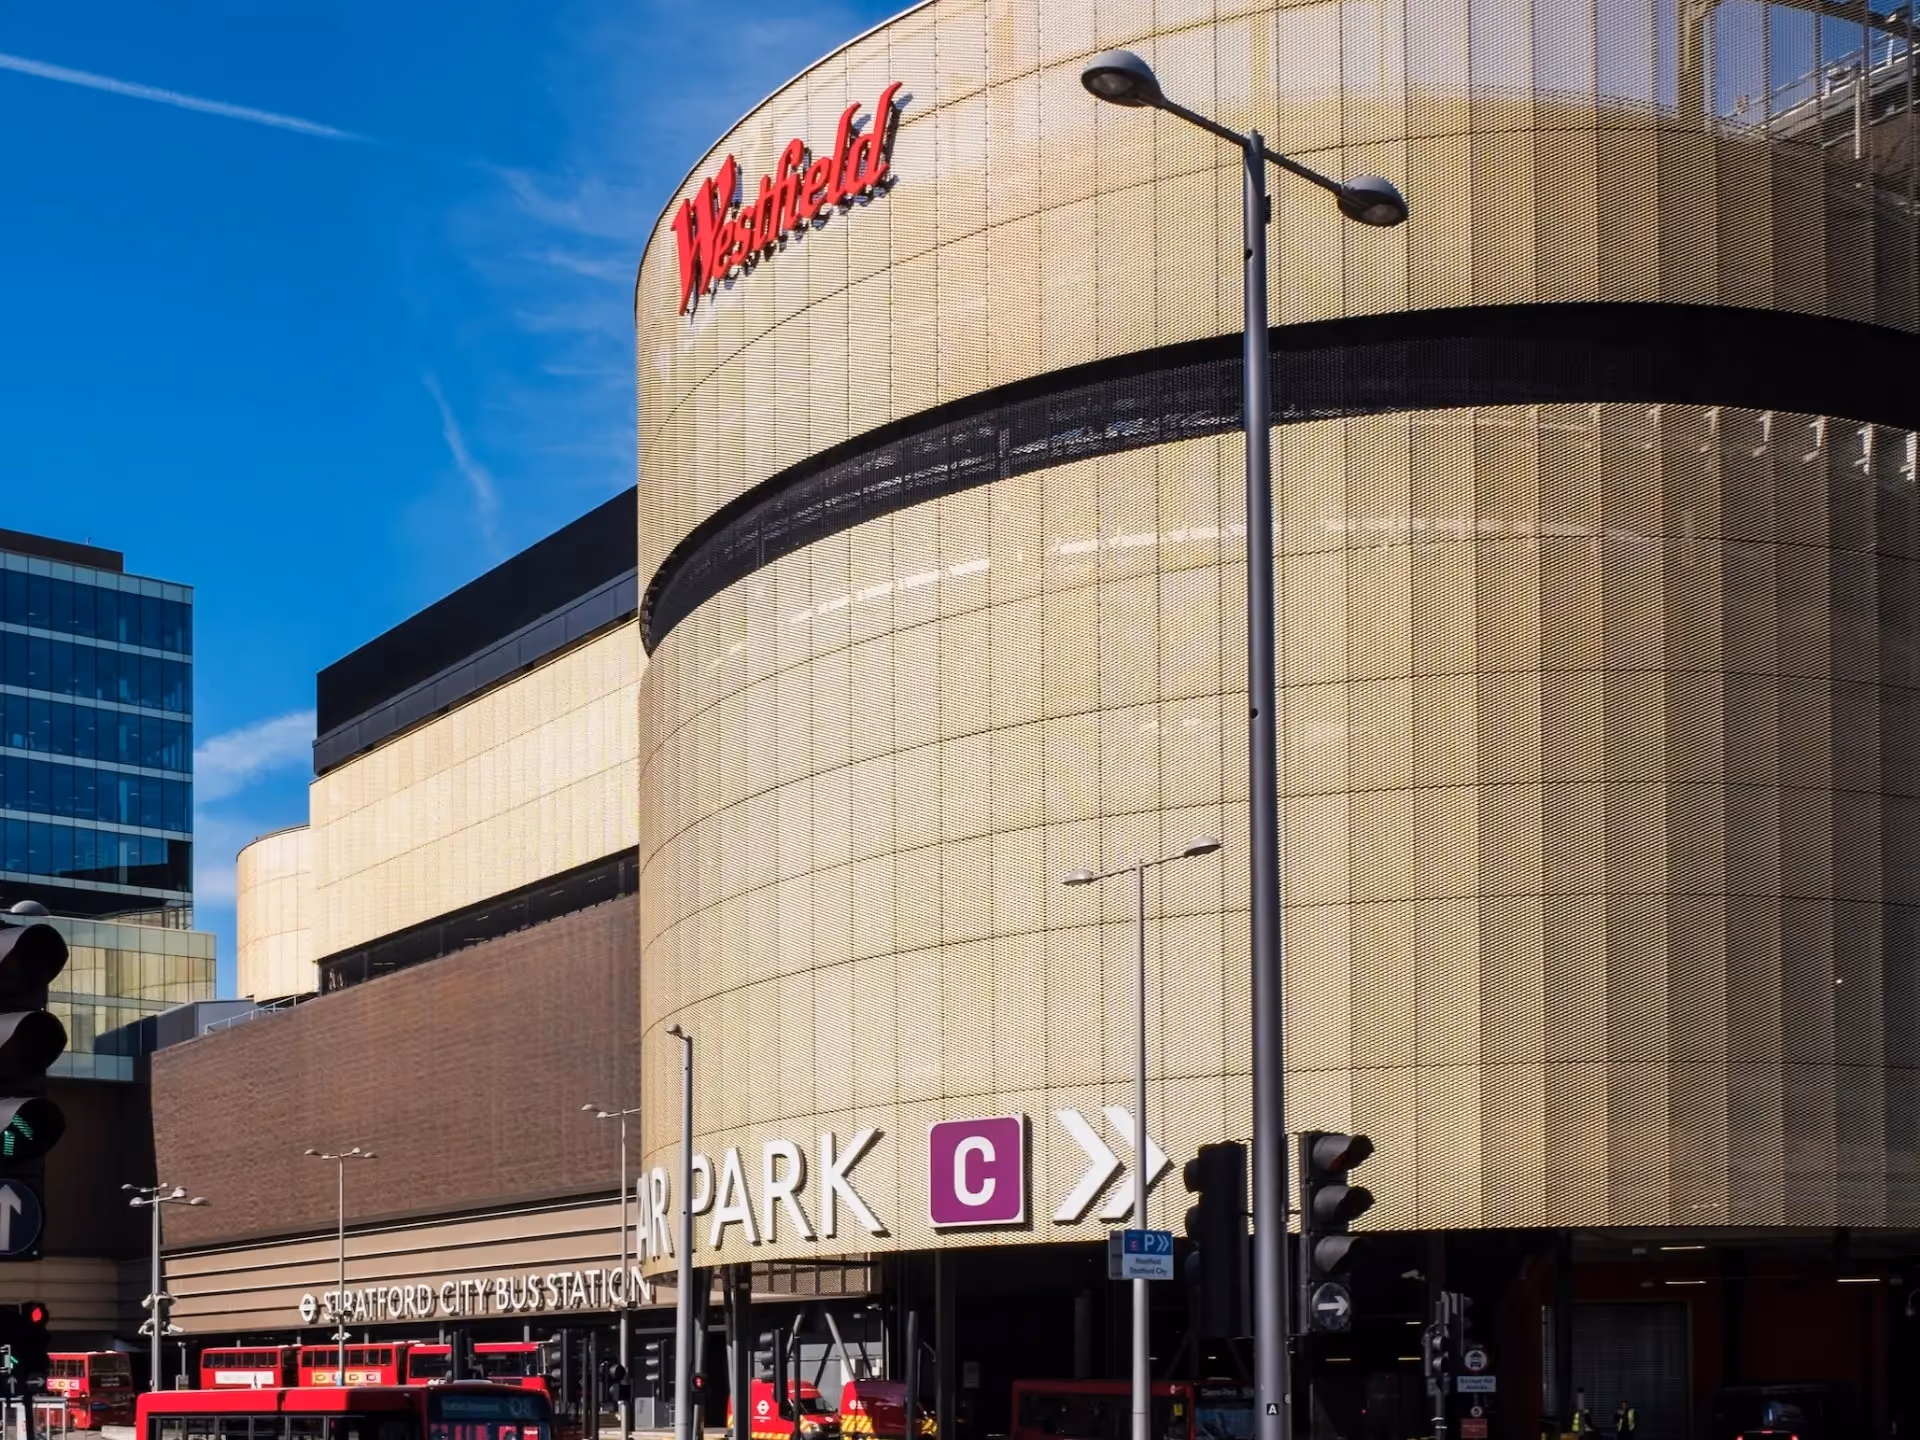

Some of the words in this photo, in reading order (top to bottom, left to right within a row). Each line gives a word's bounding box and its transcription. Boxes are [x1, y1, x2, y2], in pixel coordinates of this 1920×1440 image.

[671, 81, 902, 316] Westfield
[637, 1168, 670, 1262] AR
[690, 1127, 887, 1249] PARK
[952, 1135, 997, 1207] C
[1144, 1233, 1155, 1252] P
[323, 1283, 433, 1321] STRATFORD
[440, 1276, 489, 1315] CITY
[495, 1274, 541, 1310] BUS
[547, 1265, 650, 1307] STATION
[1267, 1403, 1278, 1415] A
